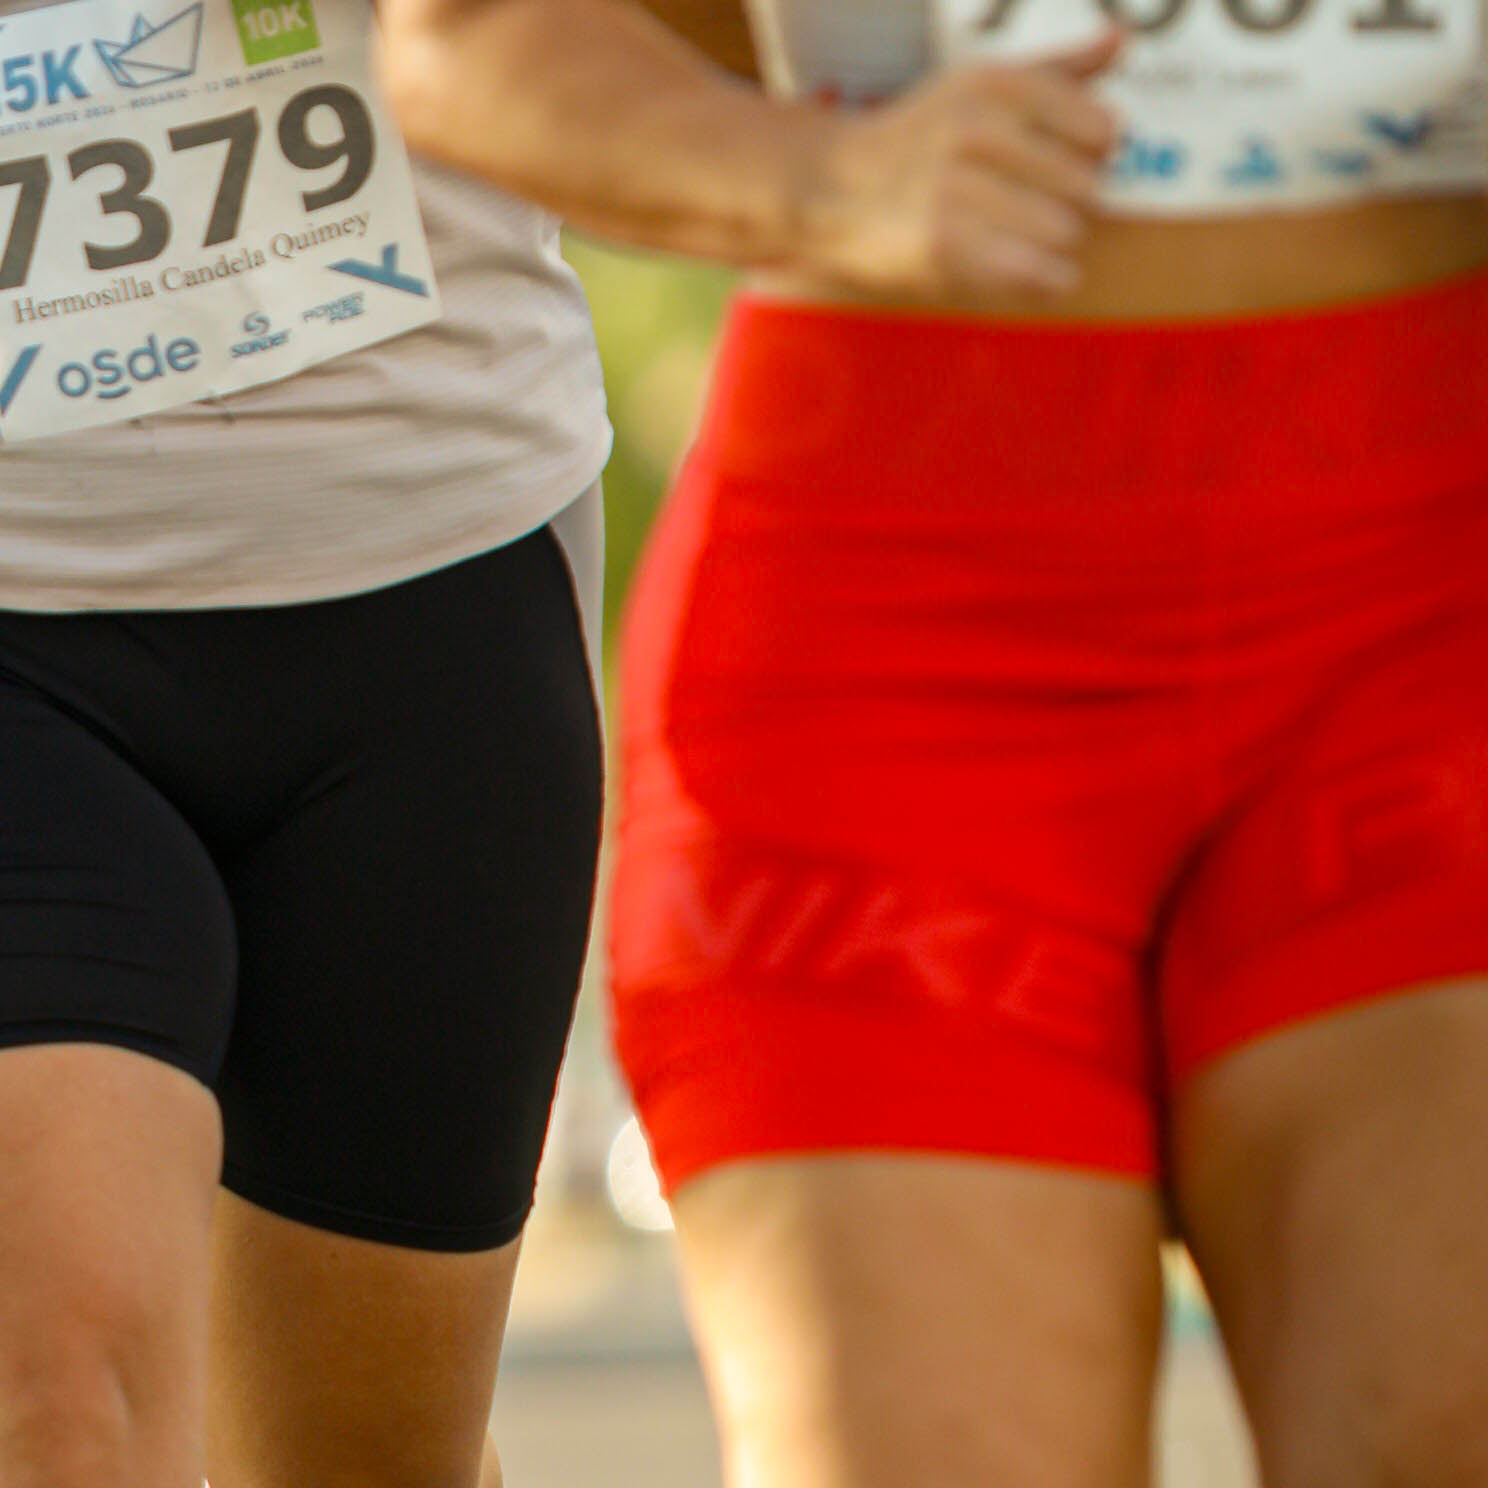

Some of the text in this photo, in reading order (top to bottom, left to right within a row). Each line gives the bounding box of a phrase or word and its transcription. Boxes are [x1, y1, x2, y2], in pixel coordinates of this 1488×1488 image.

[13, 212, 370, 325] Hermosilla Candela Quimey
[57, 332, 200, 400] osde
